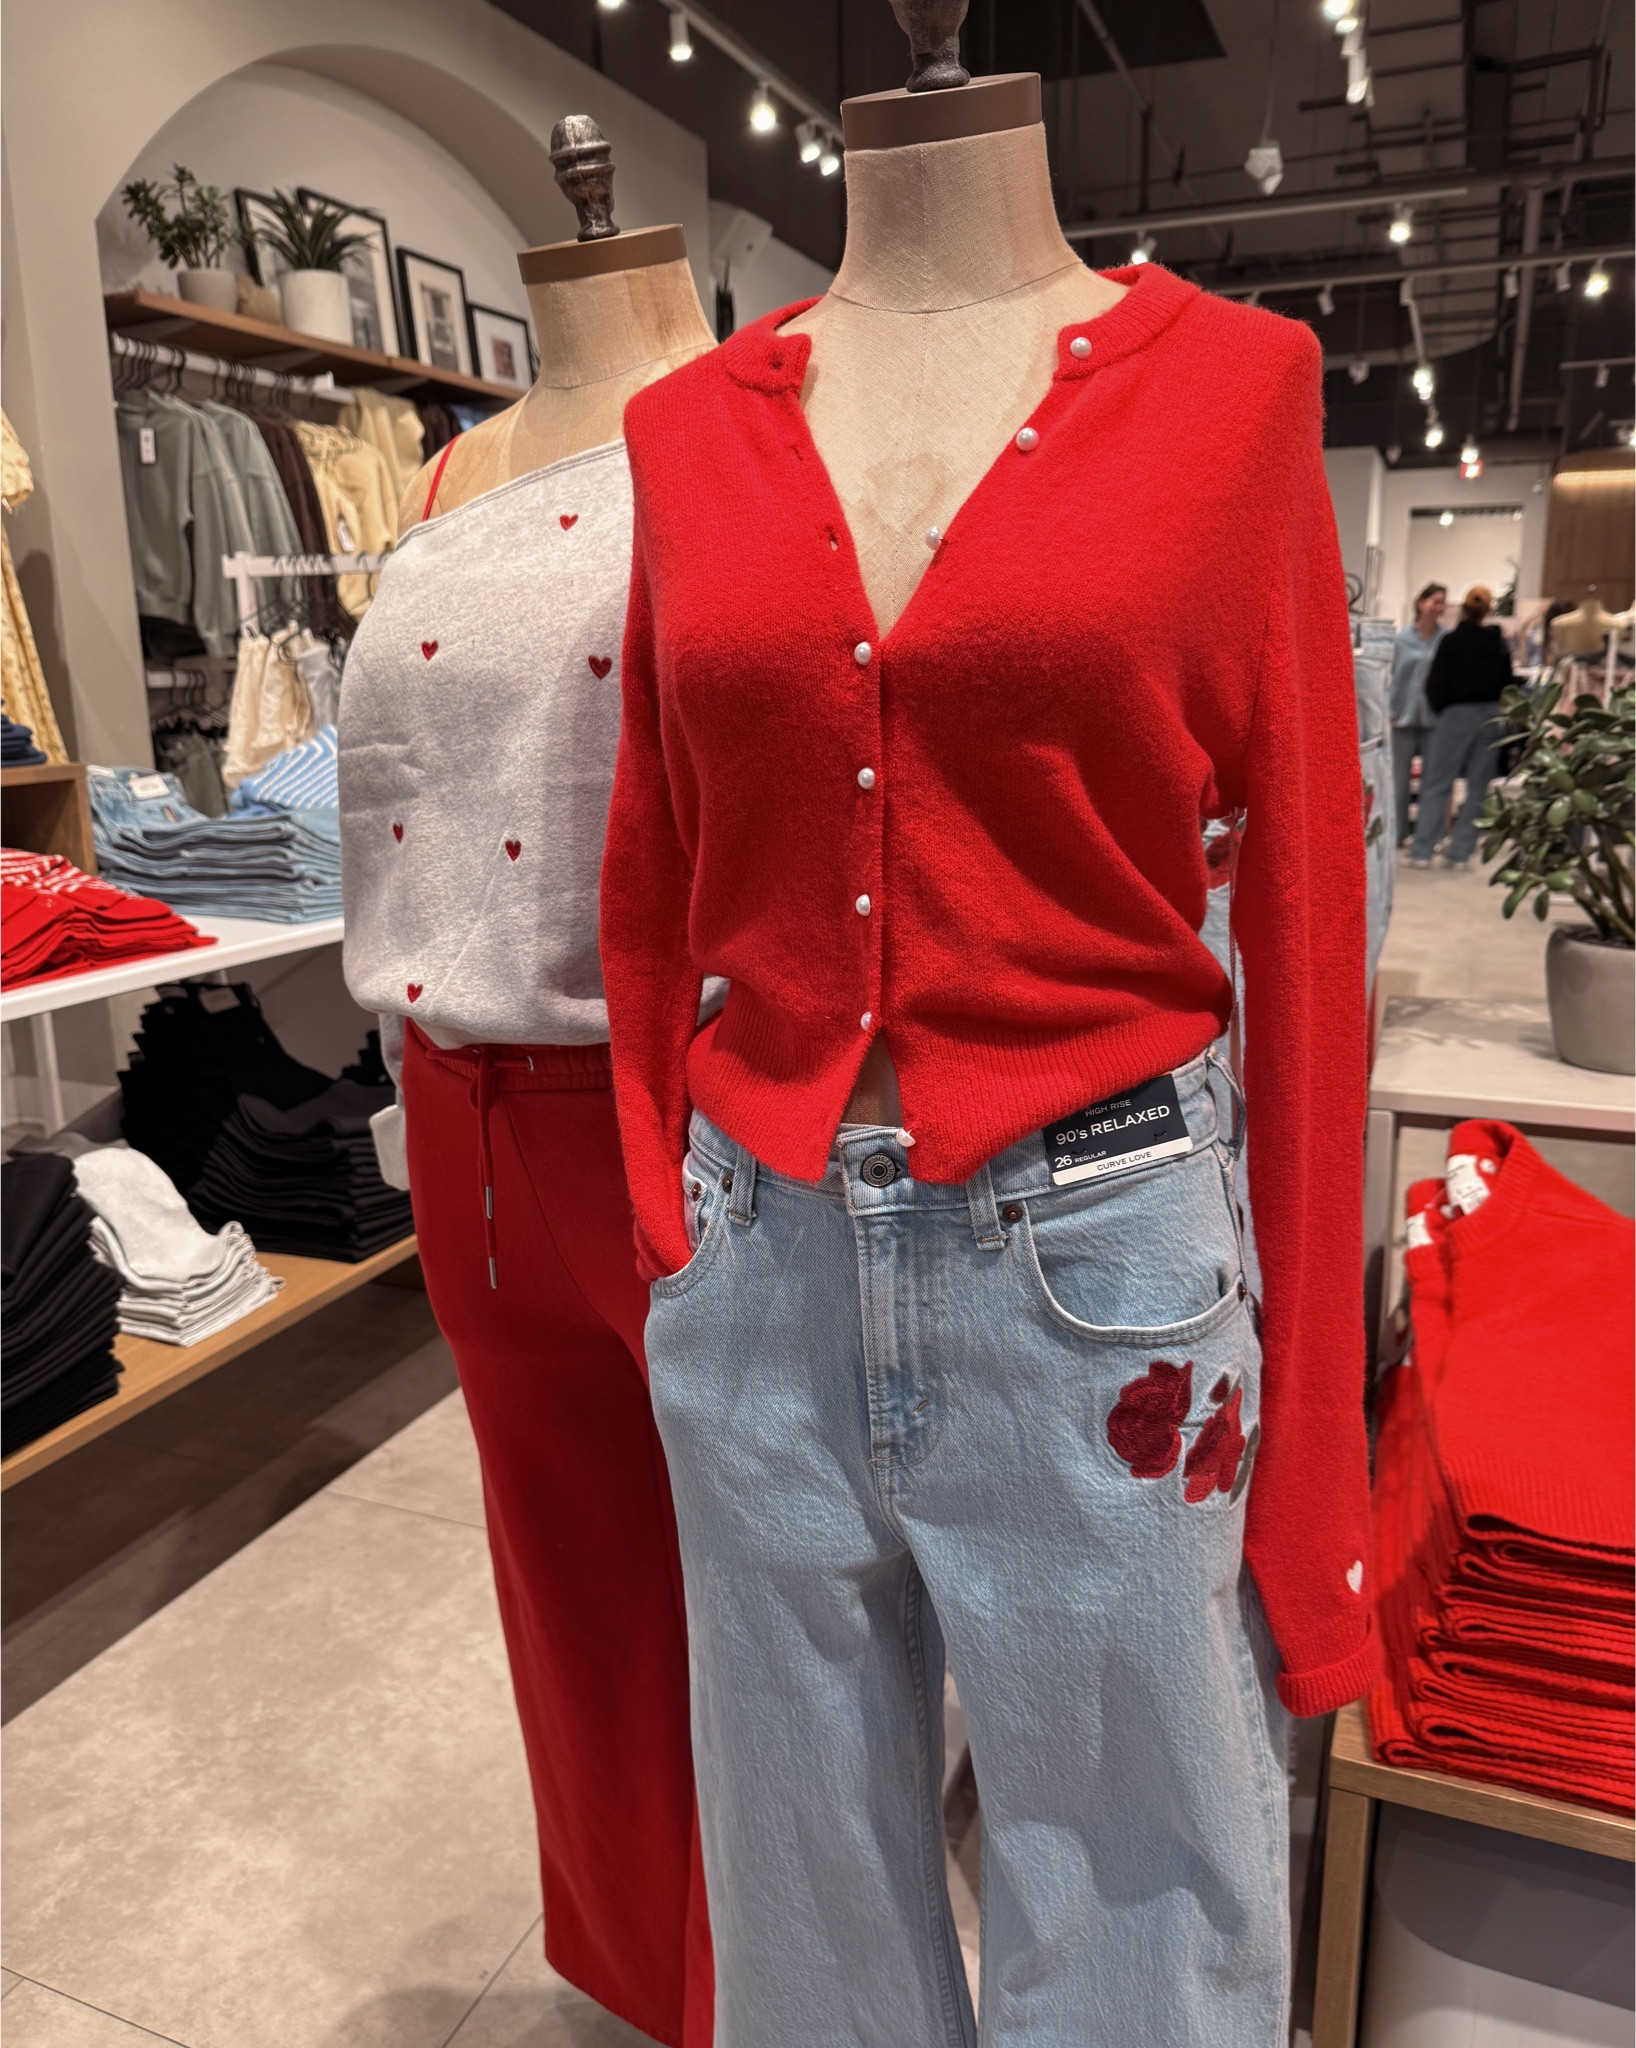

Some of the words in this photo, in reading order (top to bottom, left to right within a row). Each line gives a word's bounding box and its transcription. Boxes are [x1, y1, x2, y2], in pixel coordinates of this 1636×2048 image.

[1085, 1106, 1108, 1117] HIGH
[1110, 1099, 1132, 1109] RISE
[1055, 1128, 1088, 1145] 90's
[1090, 1105, 1170, 1136] RELAXED
[1054, 1155, 1072, 1169] 26
[1074, 1150, 1107, 1163] REGULAR
[1097, 1158, 1127, 1171] CURVE
[1129, 1151, 1152, 1163] LOVE
